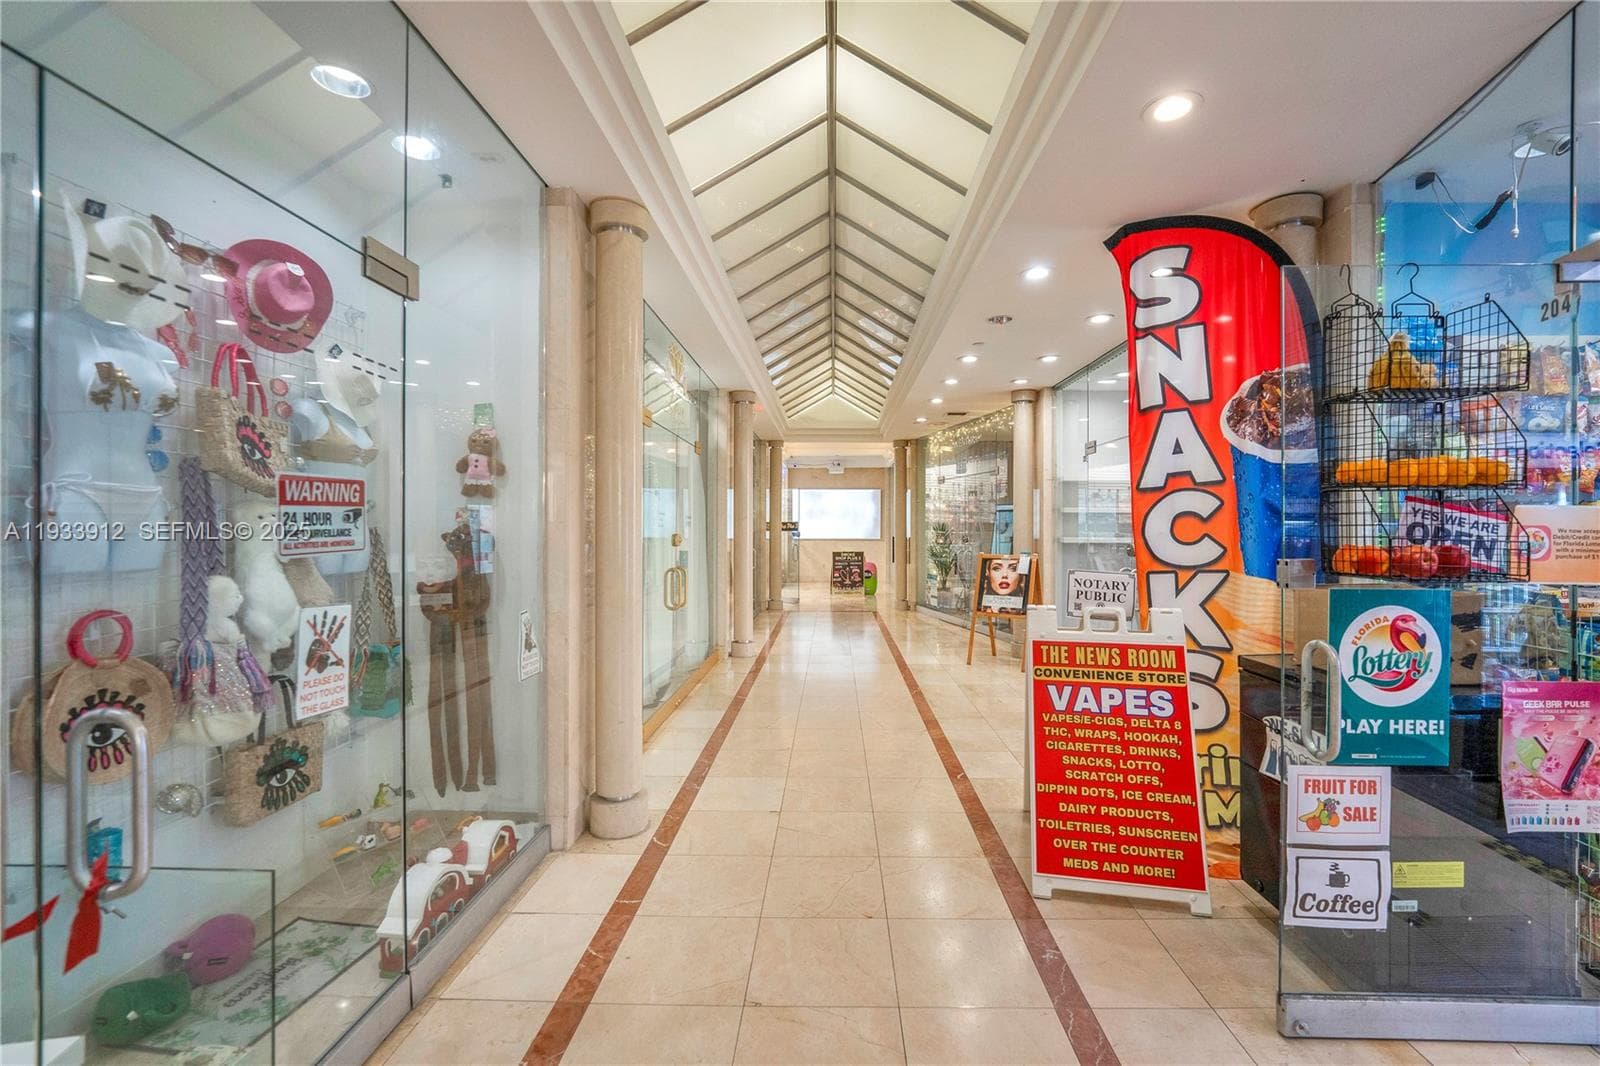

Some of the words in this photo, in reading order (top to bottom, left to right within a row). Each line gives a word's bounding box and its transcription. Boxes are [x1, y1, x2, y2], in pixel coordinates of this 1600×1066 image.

[1540, 295, 1572, 322] 204
[284, 479, 361, 503] WARNING
[1129, 244, 1232, 734] SNACKS
[283, 511, 298, 526] 24
[302, 511, 333, 527] HOUR
[1411, 507, 1440, 522] YES
[1445, 514, 1467, 528] WE
[1470, 520, 1500, 535] ARE
[306, 528, 353, 539] URVEILLANCE
[1405, 521, 1498, 561] OPEN
[1073, 577, 1130, 592] NOTARY
[1076, 589, 1127, 604] PUBLIC
[1351, 615, 1390, 647] FLORIDA
[1040, 645, 1070, 664] THE
[1075, 646, 1121, 667] NEWS
[1128, 648, 1177, 669] ROOM
[1347, 645, 1434, 688] Lottery
[303, 676, 331, 689] PLEASE
[333, 672, 345, 683] DO
[1034, 667, 1133, 682] CONVENIENCE
[1138, 672, 1186, 685] STORE
[1046, 683, 1175, 718] VAPES
[1522, 700, 1545, 709] GEEK
[1545, 700, 1563, 709] BAR
[1563, 700, 1591, 709] PULSE
[1042, 713, 1128, 728] VAPES/E-CIGS,
[1131, 718, 1171, 730] DELTA
[1174, 721, 1182, 730] 8
[1389, 719, 1445, 736] HERE!
[1043, 726, 1072, 738] THC,
[1074, 728, 1121, 741] WRAPS,
[1124, 732, 1182, 746] HOOKAH,
[1045, 740, 1126, 756] CIGARETTES,
[1129, 745, 1181, 760] DRINKS,
[1062, 755, 1116, 769] SNACKS,
[1119, 759, 1165, 773] LOTTO,
[1065, 769, 1124, 783] SCRATCH
[1127, 774, 1164, 788] OFFS,
[1303, 778, 1347, 795] FRUIT
[1349, 779, 1377, 795] FOR
[1036, 783, 1078, 796] DIPPIN
[1081, 786, 1119, 800] DOTS,
[1122, 789, 1143, 801] ICE
[1146, 792, 1196, 807] CREAM,
[1058, 802, 1097, 815] DAIRY
[1100, 806, 1174, 823] PRODUCTS,
[1343, 806, 1377, 822] SALE
[1038, 818, 1115, 837] TOILETRIES,
[1118, 826, 1199, 843] SUNSCREEN
[1053, 838, 1088, 851] OVER
[1091, 841, 1117, 854] THE
[1120, 845, 1185, 861] COUNTER
[1063, 857, 1099, 871] MEDS
[1102, 861, 1130, 874] AND
[1133, 865, 1176, 879] MORE!
[1299, 892, 1375, 915] Coffee
